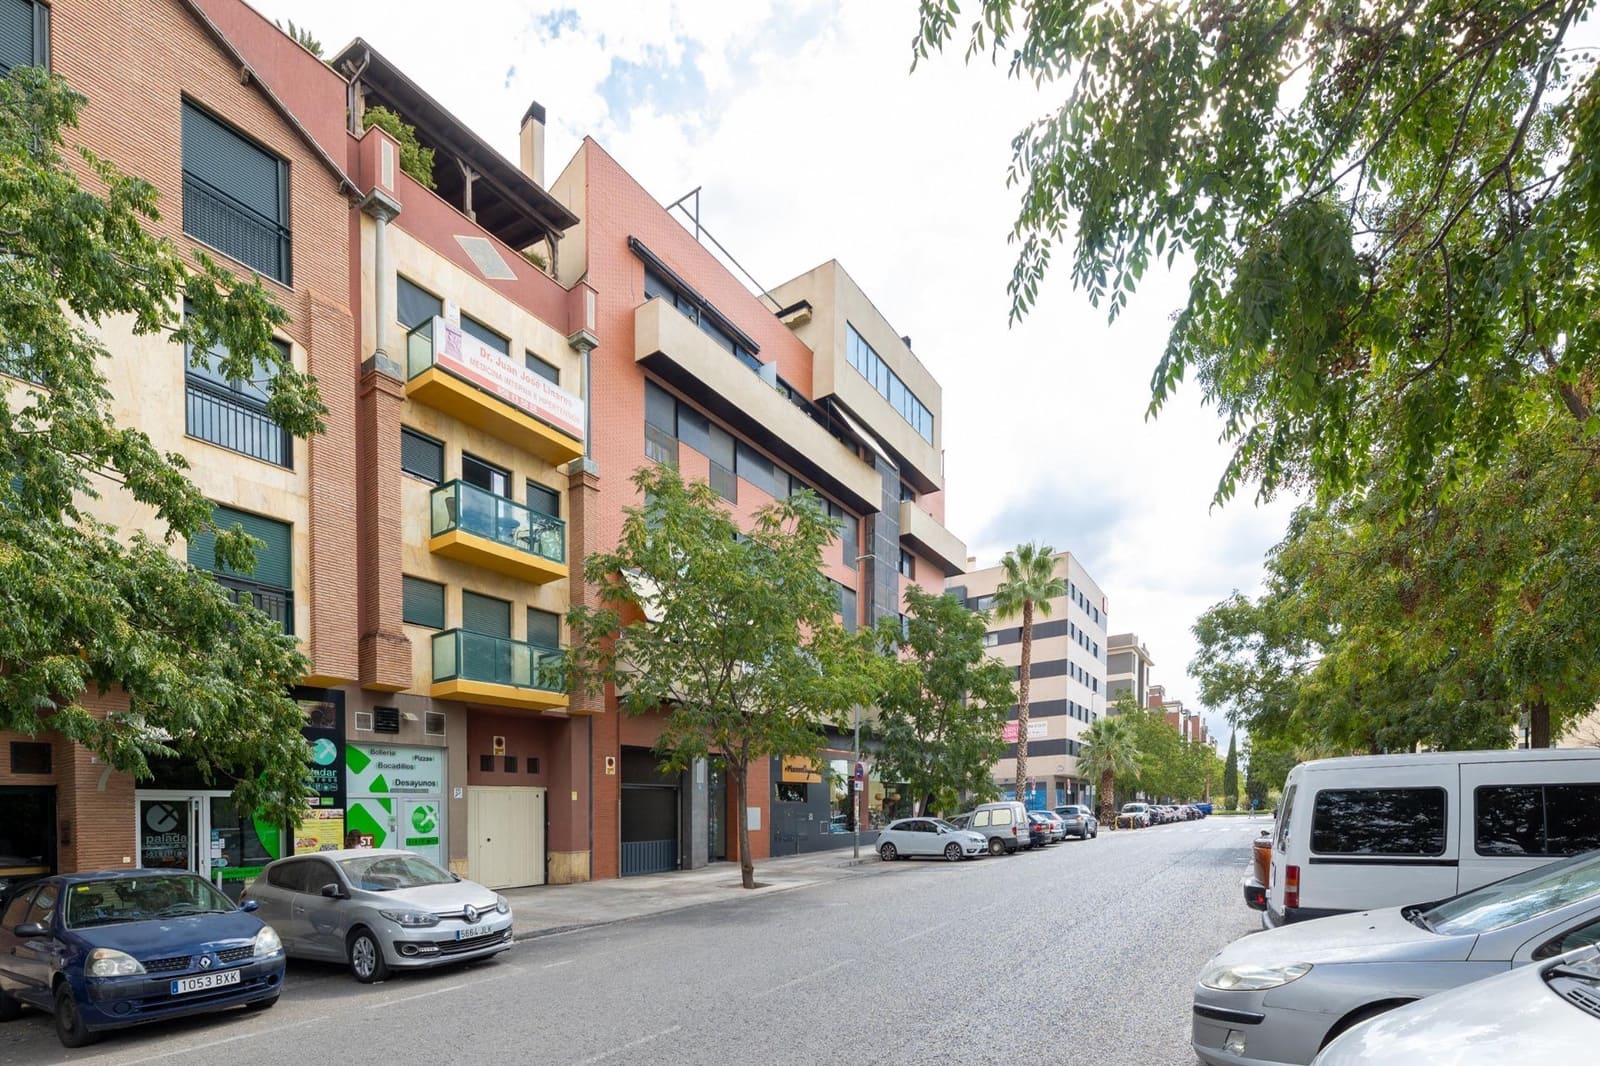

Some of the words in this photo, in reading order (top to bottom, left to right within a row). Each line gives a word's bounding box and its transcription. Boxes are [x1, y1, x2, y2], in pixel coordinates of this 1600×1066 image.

[479, 347, 493, 363] Dr.
[495, 356, 518, 376] Juan
[377, 762, 414, 770] Bocadillos
[395, 778, 436, 788] Desayunos
[145, 833, 187, 845] palada
[182, 976, 212, 991] 1053
[215, 972, 237, 985] BXK
